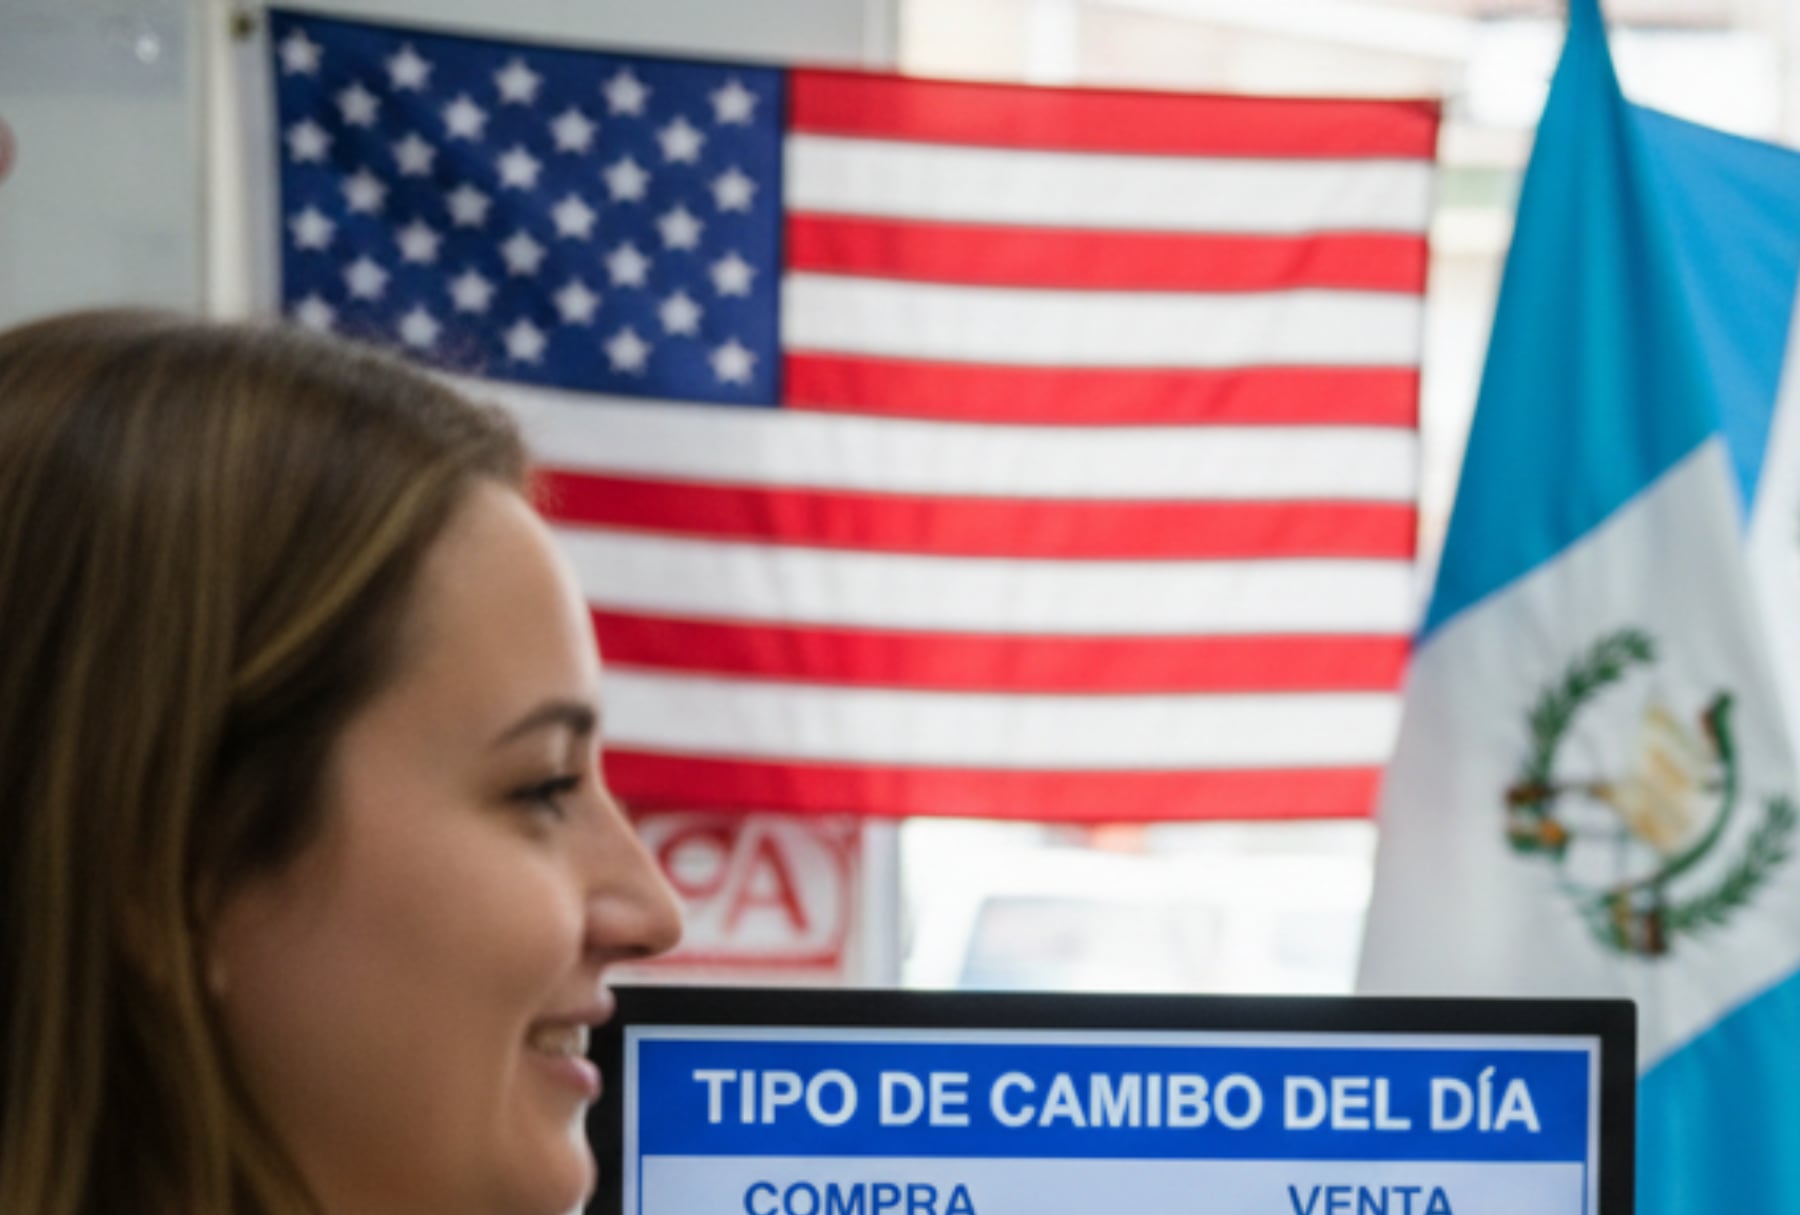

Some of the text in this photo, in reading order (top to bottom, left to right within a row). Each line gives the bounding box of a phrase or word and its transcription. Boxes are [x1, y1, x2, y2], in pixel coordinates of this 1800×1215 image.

[692, 1065, 1541, 1133] TIPO DE CAMIBO DEL DÍA
